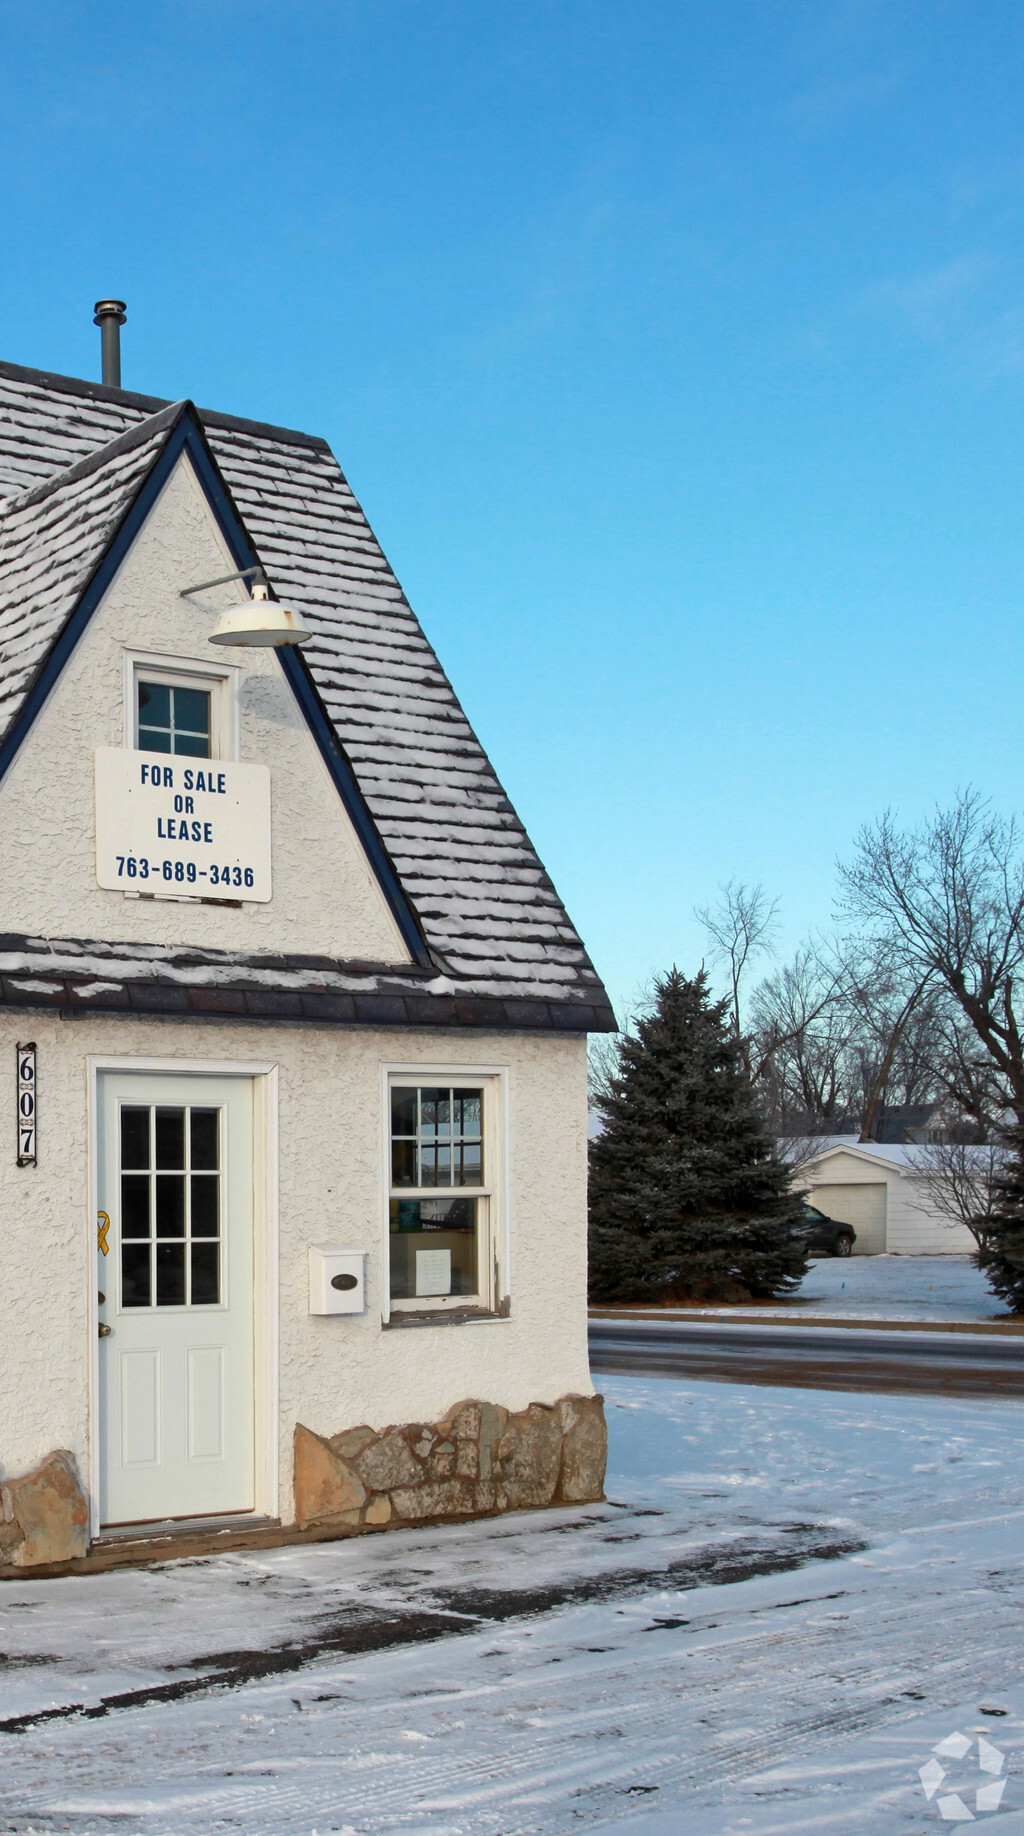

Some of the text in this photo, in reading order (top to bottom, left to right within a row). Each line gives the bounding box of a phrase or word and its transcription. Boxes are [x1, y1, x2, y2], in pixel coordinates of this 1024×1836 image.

[141, 764, 226, 794] FOR SALE
[174, 795, 194, 814] OR
[157, 817, 213, 843] LEASE
[116, 856, 254, 887] 763-689-3436
[20, 1057, 34, 1153] 607
